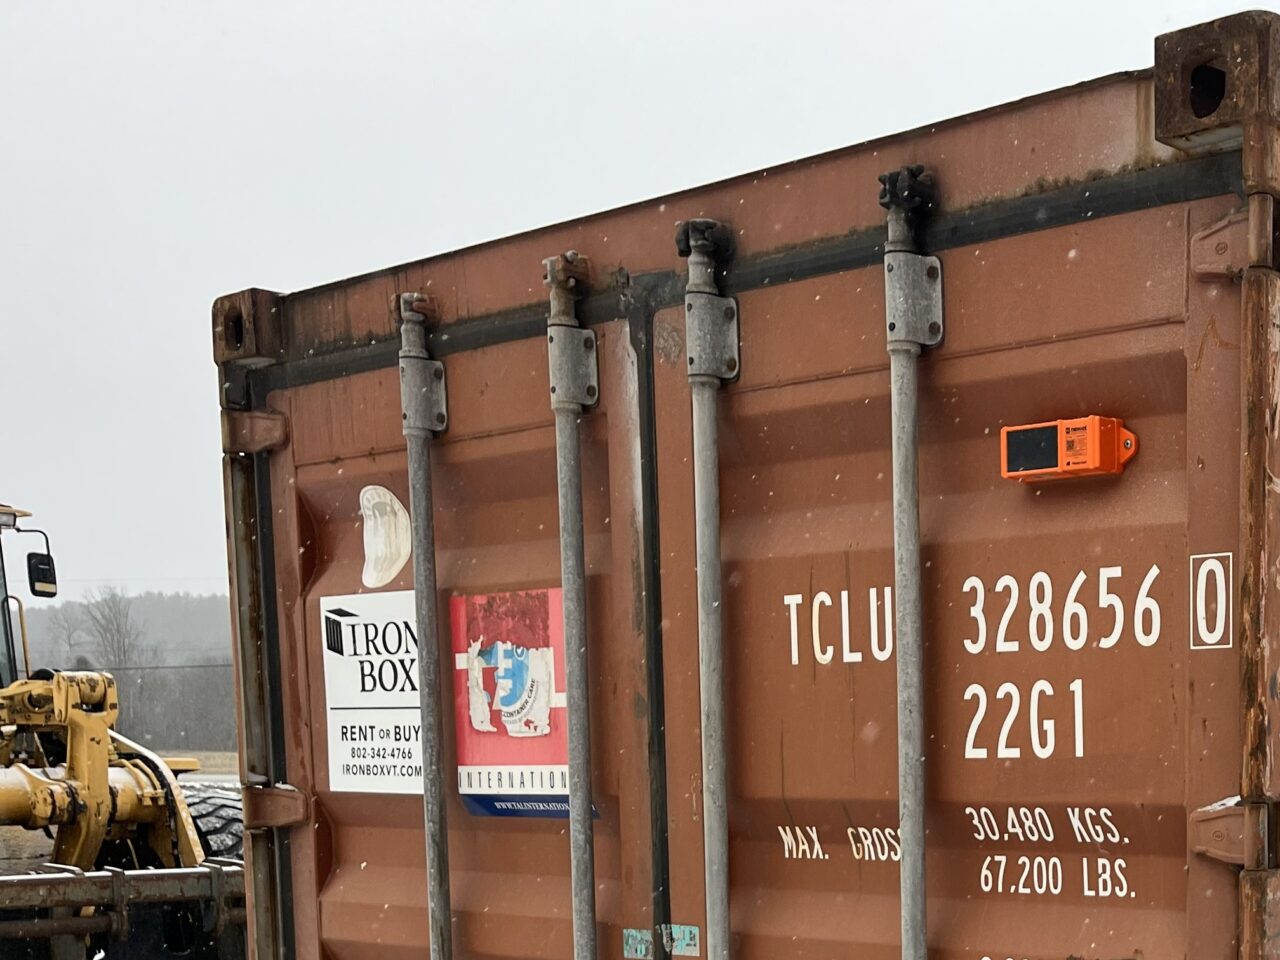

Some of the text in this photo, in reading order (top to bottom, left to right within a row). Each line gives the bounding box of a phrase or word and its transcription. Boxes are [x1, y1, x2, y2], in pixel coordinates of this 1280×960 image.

[784, 557, 1227, 665] TCLU 328656 0
[346, 621, 418, 656] IRON
[358, 658, 418, 692] BOX
[341, 725, 421, 742] RENT OR BUY
[963, 678, 1084, 759] 22G1
[342, 763, 422, 777] IRONBOXVT.COM
[350, 747, 413, 759] 802-342-4766
[458, 771, 568, 788] INTERNATION
[778, 825, 829, 860] MAX.
[846, 826, 901, 861] GROS
[1067, 807, 1130, 844] KGS.
[1082, 857, 1136, 898] LBS.
